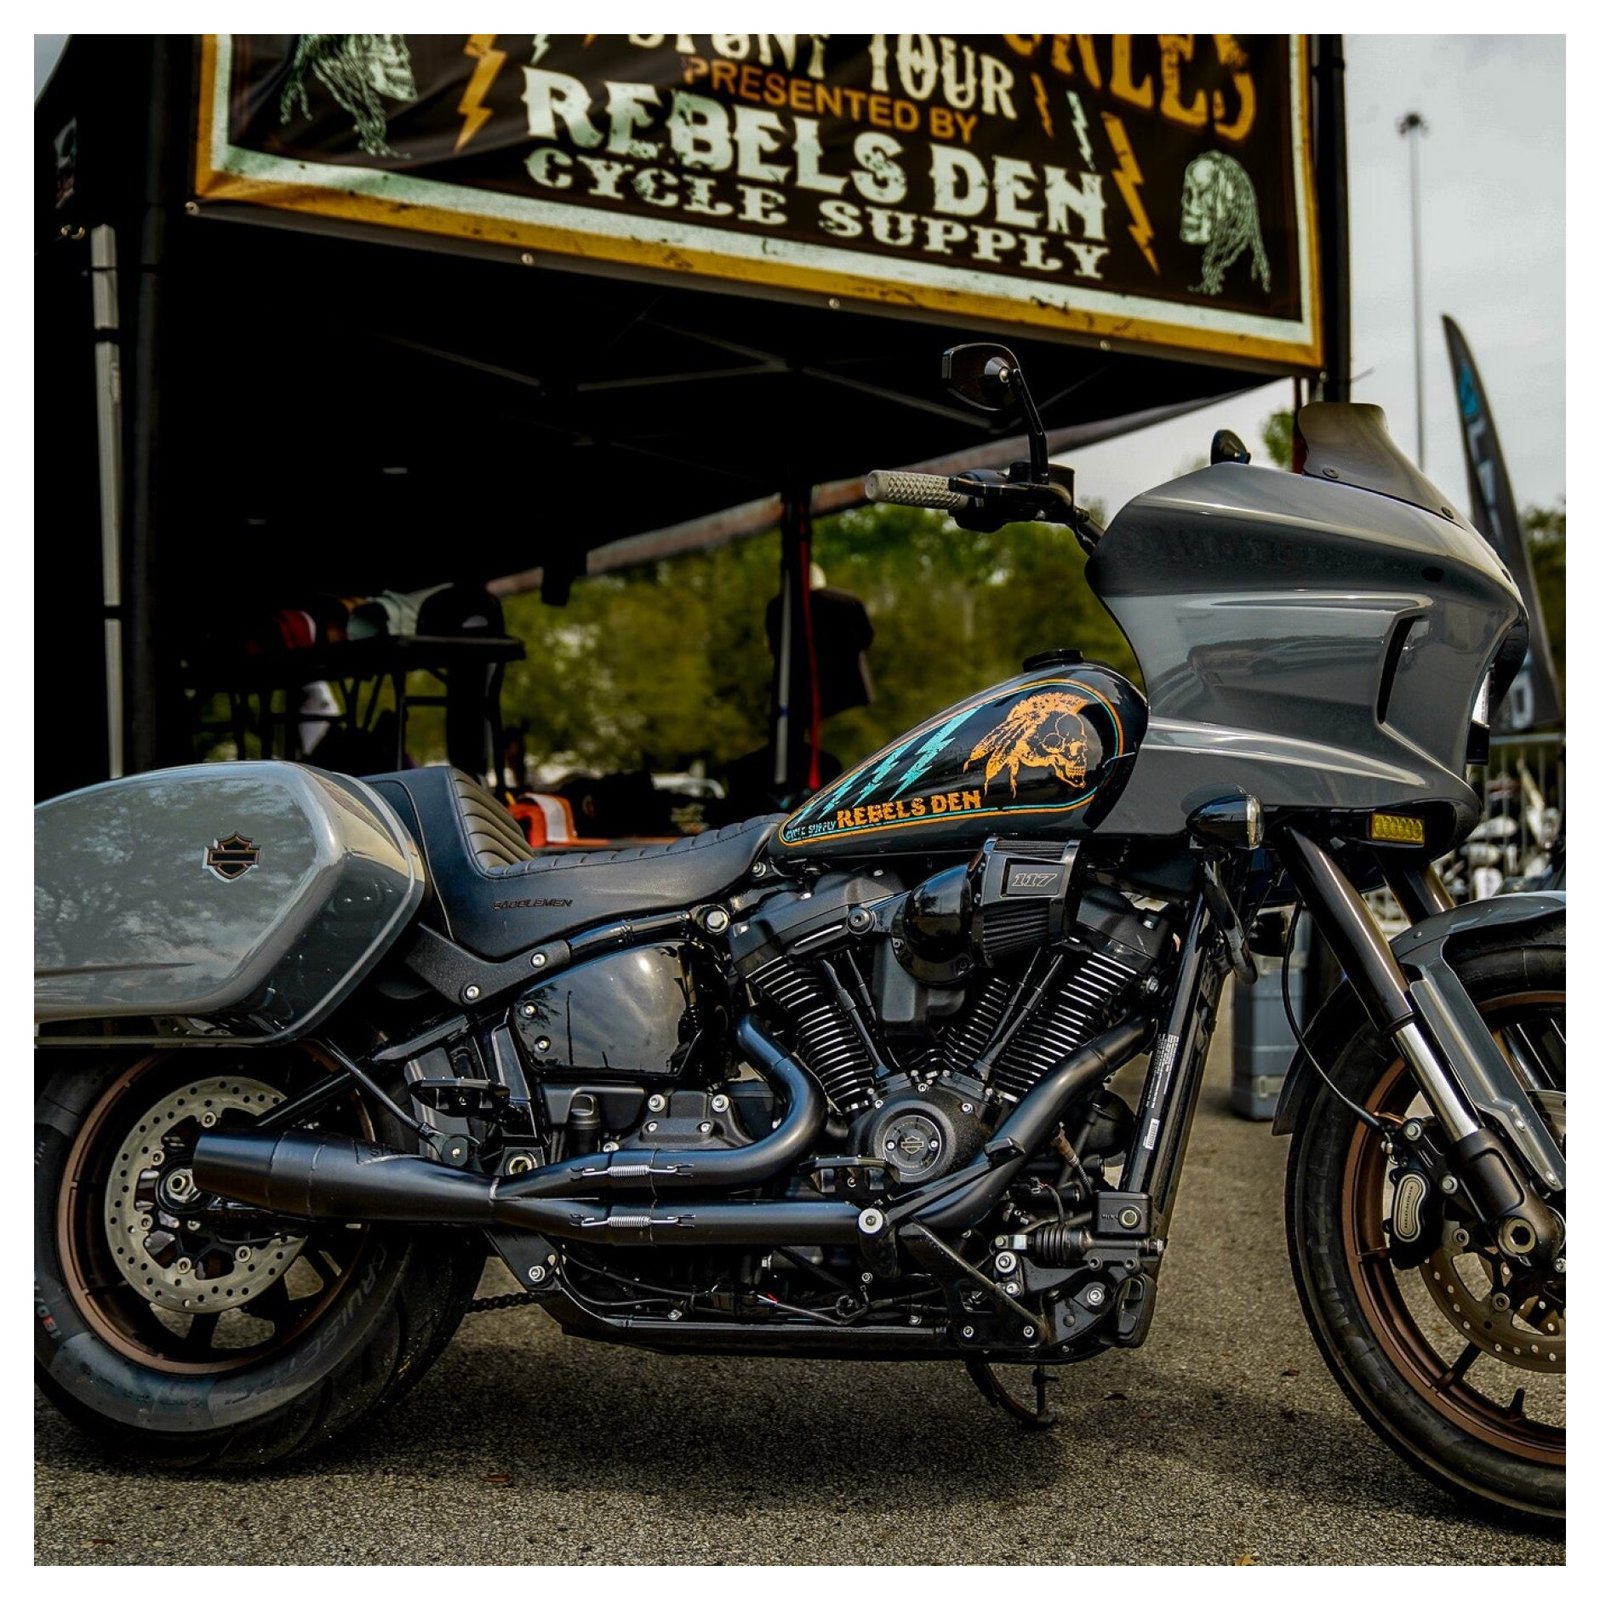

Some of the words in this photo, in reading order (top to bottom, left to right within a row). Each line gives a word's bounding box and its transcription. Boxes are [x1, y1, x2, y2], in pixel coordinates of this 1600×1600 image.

[683, 55, 921, 132] PRESENTED
[929, 106, 978, 144] BY
[867, 34, 1018, 120] TOUR
[520, 66, 909, 204] REBELS
[928, 143, 1107, 241] DEN
[523, 147, 788, 226] CYCLE
[818, 199, 1110, 279] SUPPLY
[807, 820, 837, 835] SUPPLY
[836, 797, 926, 829] REBELS
[930, 789, 982, 814] DEN
[491, 897, 574, 912] SADDLEMEN
[1011, 872, 1058, 888] 117
